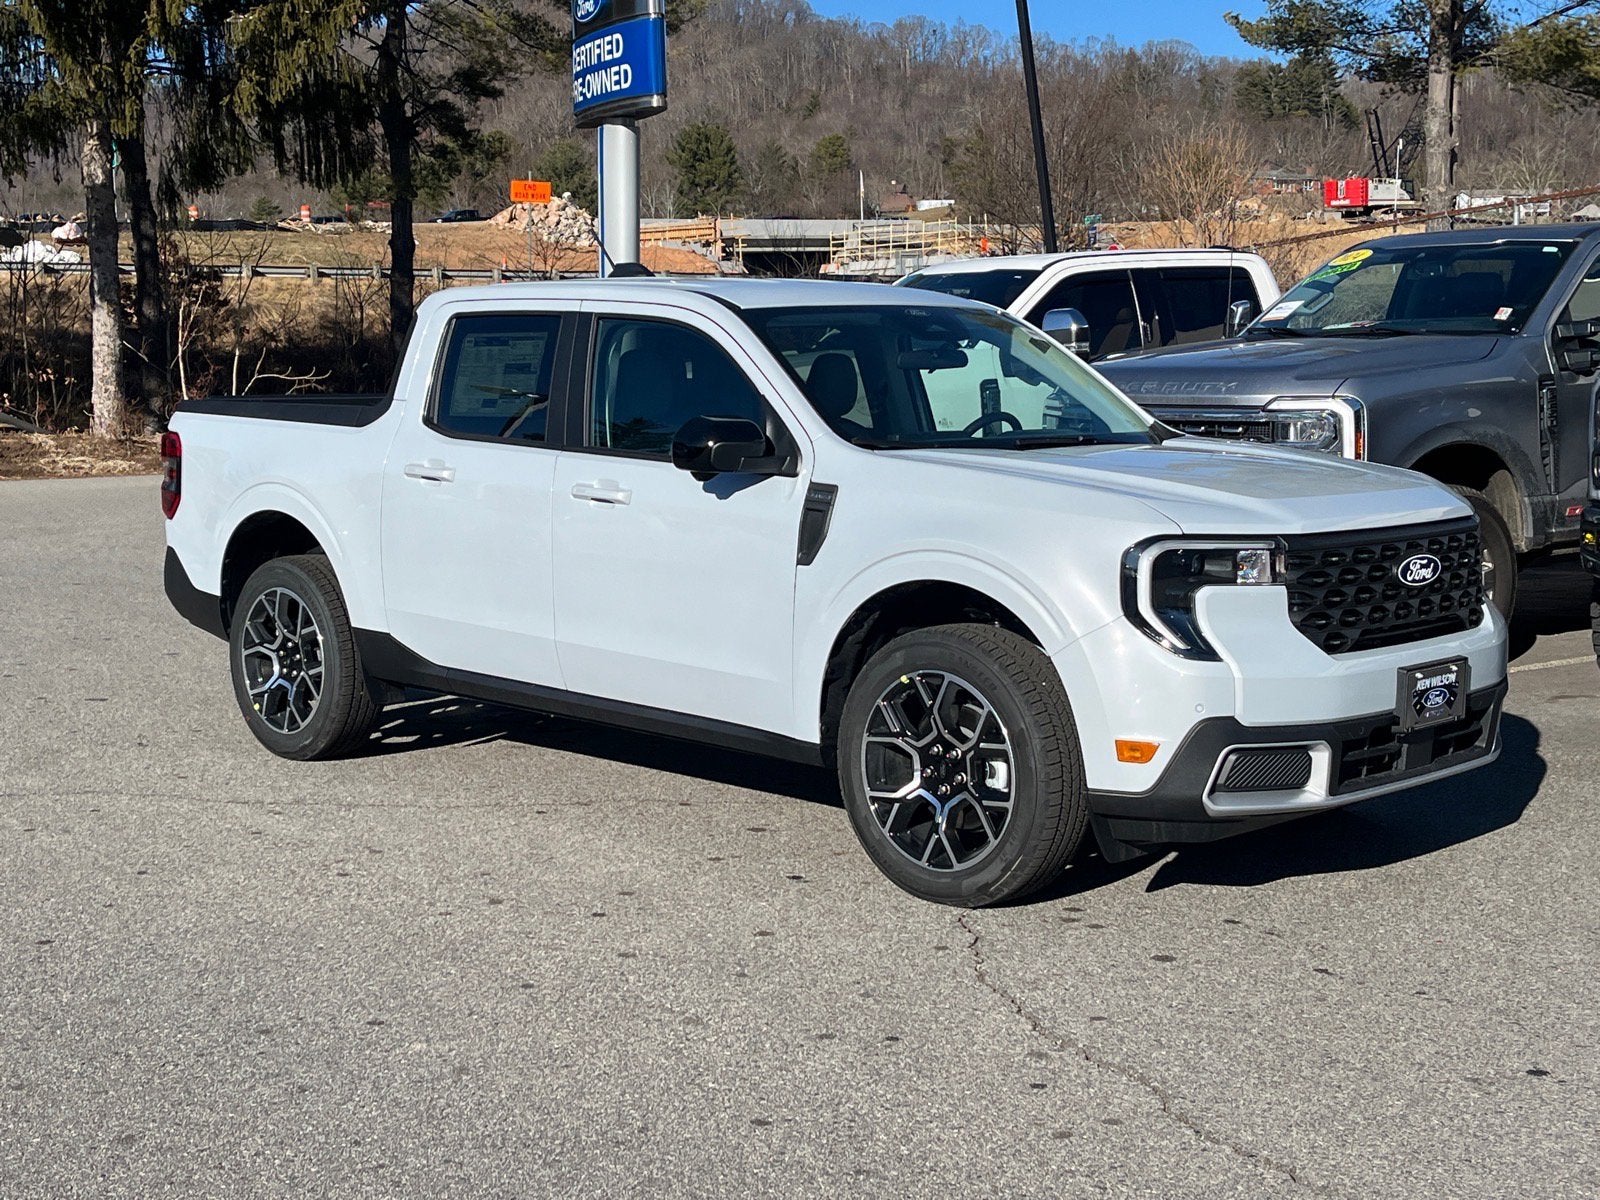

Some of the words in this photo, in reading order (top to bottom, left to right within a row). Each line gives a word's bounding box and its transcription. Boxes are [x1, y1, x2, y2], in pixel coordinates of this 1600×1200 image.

[576, 0, 595, 17] Ford
[573, 63, 632, 103] RE-OWNED
[524, 183, 537, 191] END
[1406, 559, 1434, 581] Ford
[1416, 678, 1431, 691] KEN
[1429, 672, 1457, 688] WILSON
[1427, 691, 1444, 706] Ford
